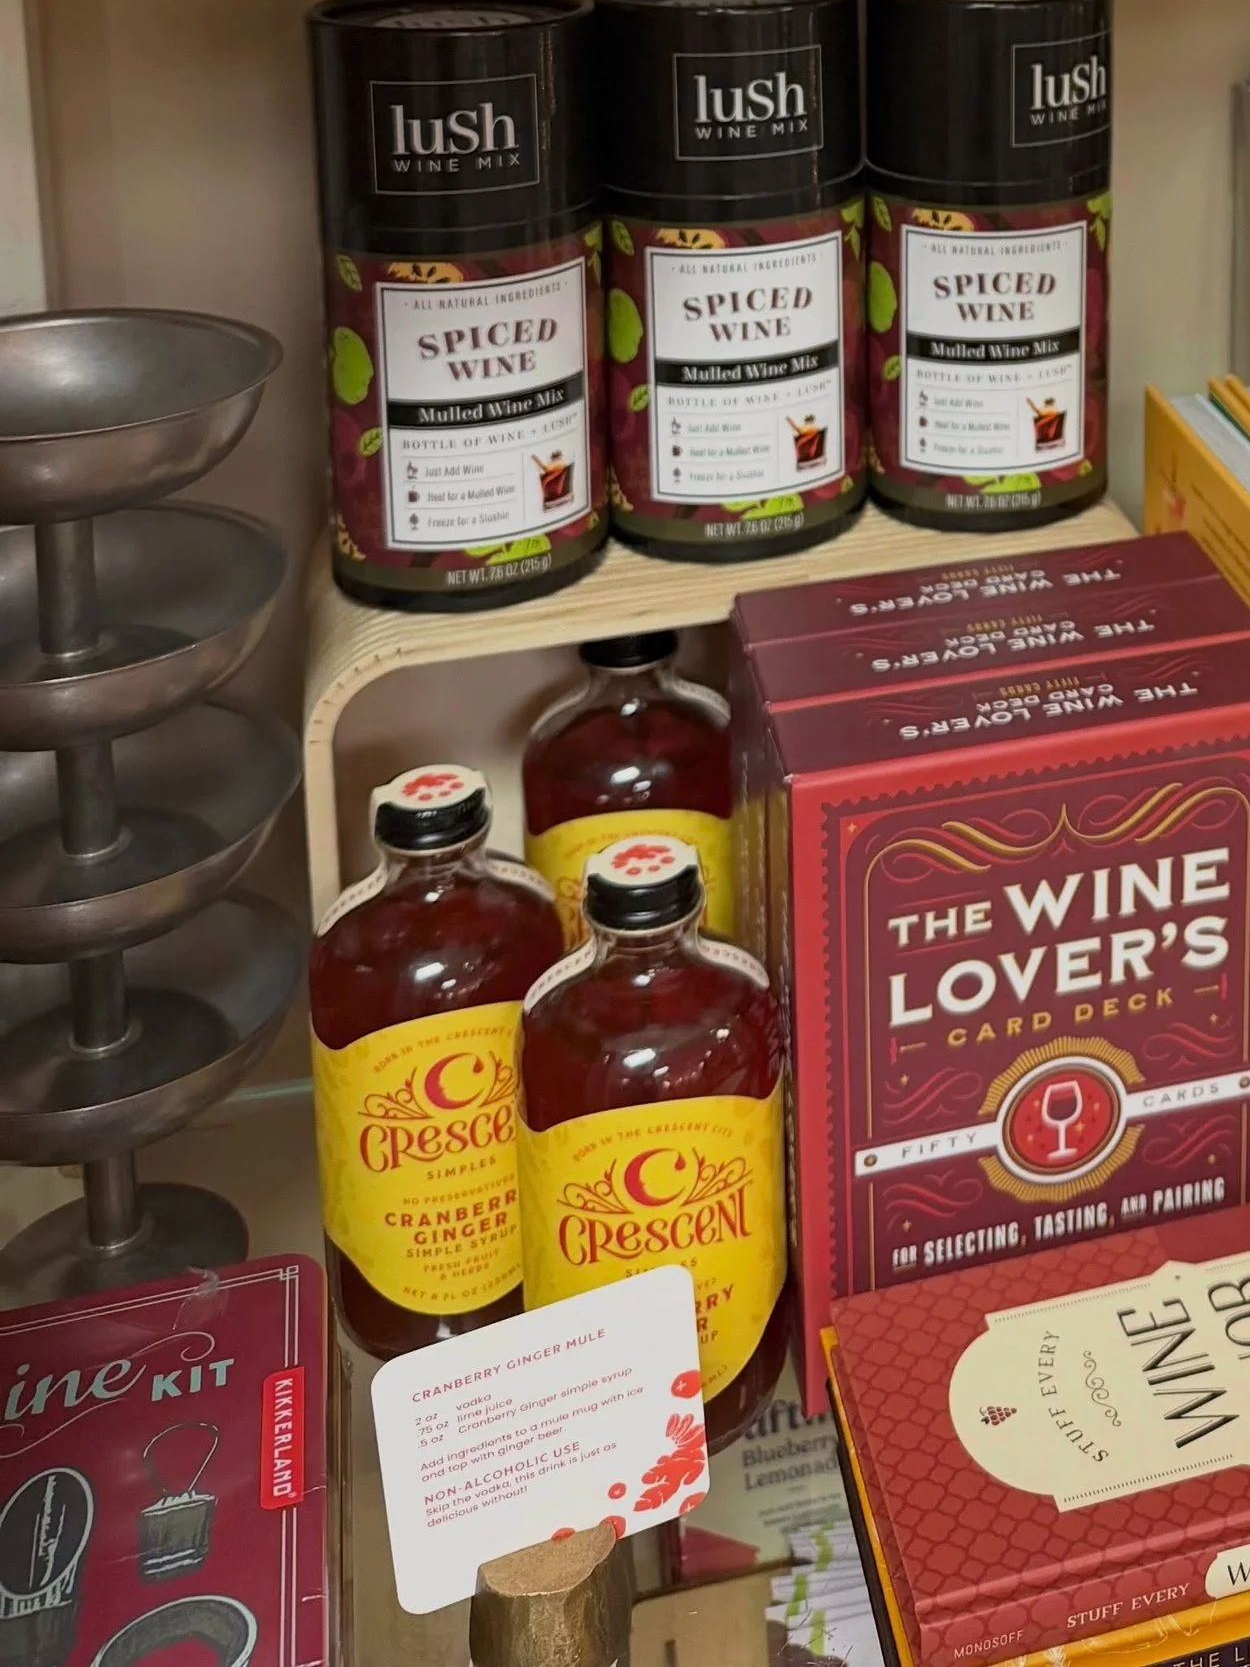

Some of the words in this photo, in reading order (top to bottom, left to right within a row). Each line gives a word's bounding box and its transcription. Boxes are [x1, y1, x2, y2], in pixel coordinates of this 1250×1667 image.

[393, 157, 460, 174] WINE
[477, 153, 521, 170] MIX
[412, 297, 436, 312] ALL
[440, 292, 492, 310] NATURAL
[683, 285, 814, 322] SPICED
[933, 270, 1057, 301] SPICED
[708, 317, 792, 344] WINE
[958, 301, 1035, 323] WINE
[417, 316, 559, 362] SPICED
[447, 350, 537, 383] WINE
[418, 401, 479, 426] Mulled
[482, 396, 533, 419] Wine
[535, 387, 566, 411] Mix
[888, 902, 993, 949] THE
[1003, 848, 1231, 935] WINE
[889, 916, 1231, 1028] LOVER'S
[947, 1011, 1053, 1047] CARD
[1074, 987, 1175, 1024] DECK
[1143, 1082, 1222, 1108] CARDS
[901, 1132, 978, 1160] FIFTY
[426, 1156, 497, 1180] SIMPLES
[384, 1188, 517, 1228] CRANBERR
[892, 1246, 917, 1269] FOR
[923, 1221, 1028, 1267] SELECTING,
[1034, 1201, 1115, 1241] TASTING,
[1121, 1195, 1148, 1216] AND
[1152, 1178, 1226, 1212] PAIRING
[406, 1240, 462, 1259] SIMPLE
[468, 1226, 518, 1252] SYRUP
[413, 1212, 510, 1245] GINGER
[151, 1358, 235, 1402] KIT
[411, 1364, 502, 1404] CRANBERRY
[506, 1344, 563, 1371] GINGER
[566, 1328, 607, 1351] MULE
[1036, 1329, 1062, 1399] EVERY
[1116, 1295, 1241, 1449] WINE
[455, 1393, 492, 1412] vodka
[456, 1408, 483, 1424] lime
[484, 1397, 513, 1415] juice
[457, 1410, 518, 1435] Cranberry
[519, 1394, 558, 1416] Ginger
[560, 1378, 599, 1401] simple
[601, 1367, 633, 1386] syrup
[272, 1377, 294, 1499] KIKKERLAND
[1046, 1404, 1111, 1463] STUFF
[952, 1629, 1025, 1660] MONOSOFF
[1066, 1597, 1127, 1629] STUFF
[1129, 1582, 1191, 1614] EVERY
